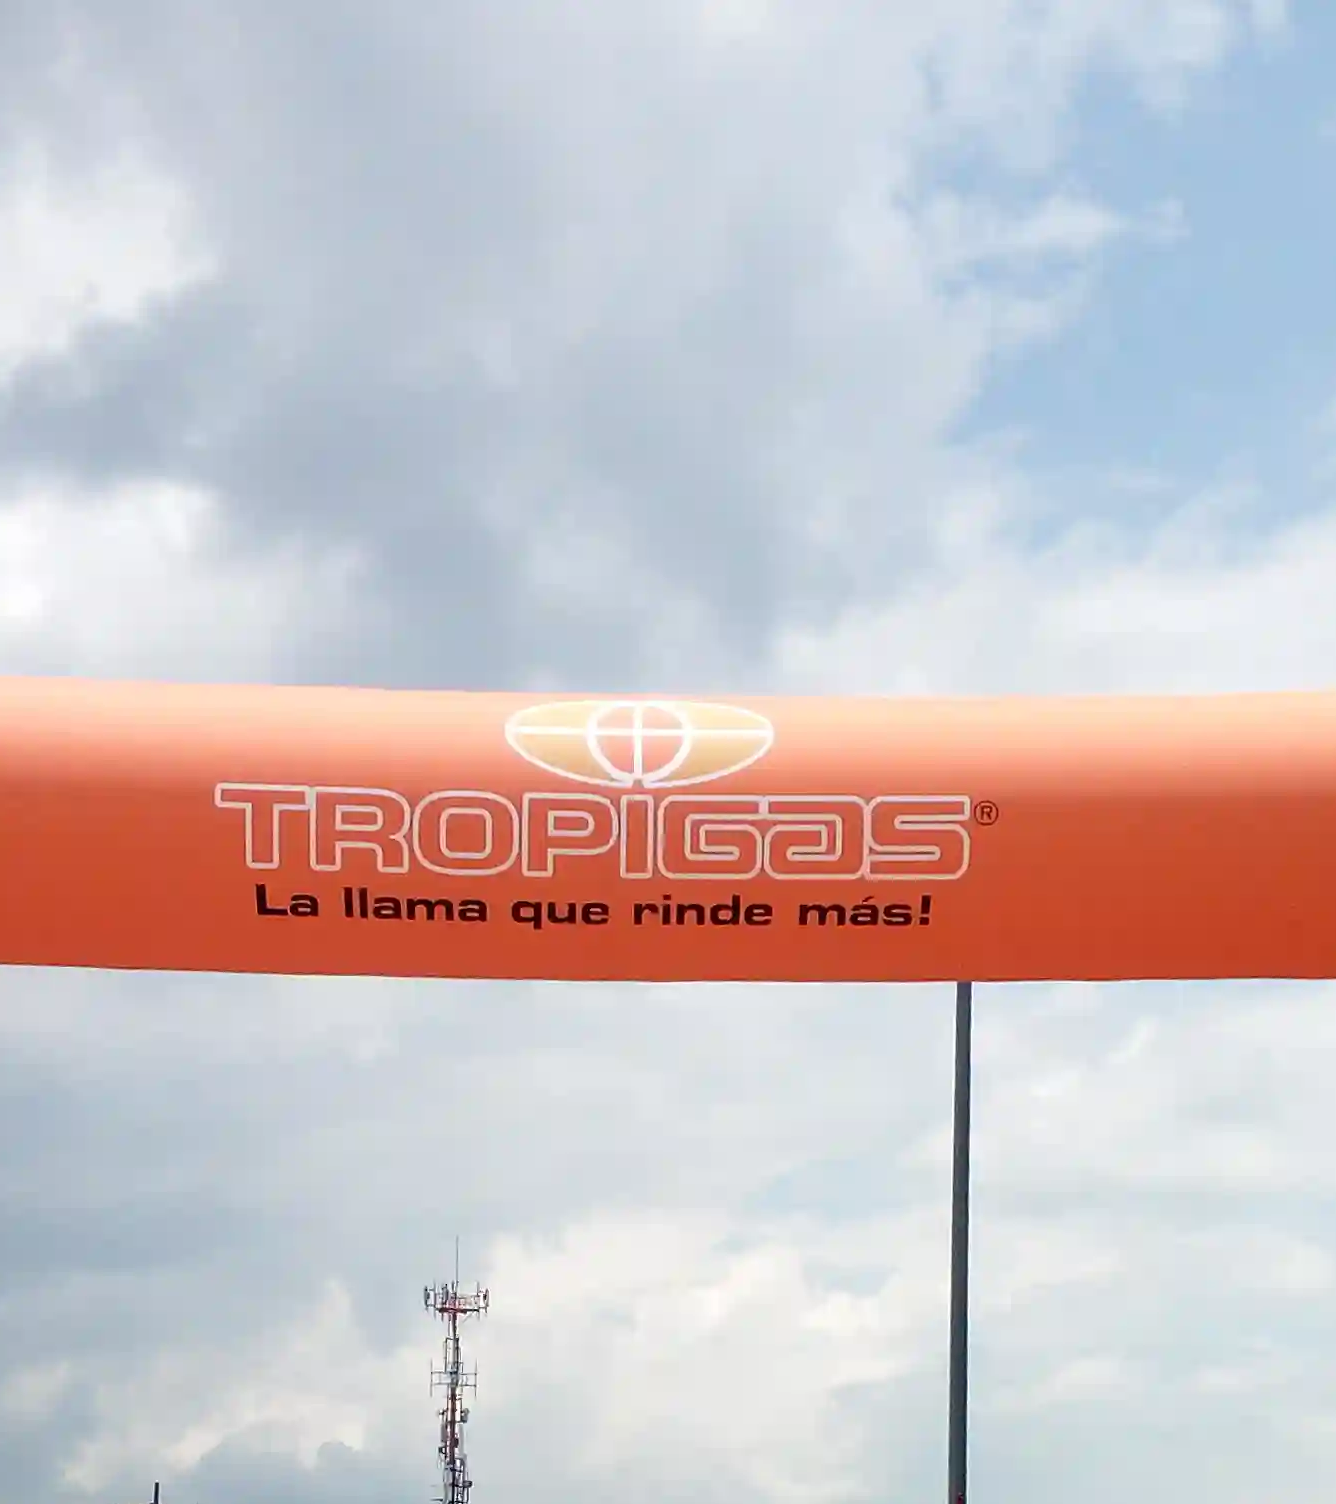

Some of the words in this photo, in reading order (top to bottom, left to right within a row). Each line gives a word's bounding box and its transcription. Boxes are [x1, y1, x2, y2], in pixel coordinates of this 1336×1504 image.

[255, 883, 320, 918] La
[343, 886, 489, 923] llama
[512, 898, 611, 931] que
[632, 892, 774, 926] rinde
[798, 894, 934, 928] más!
